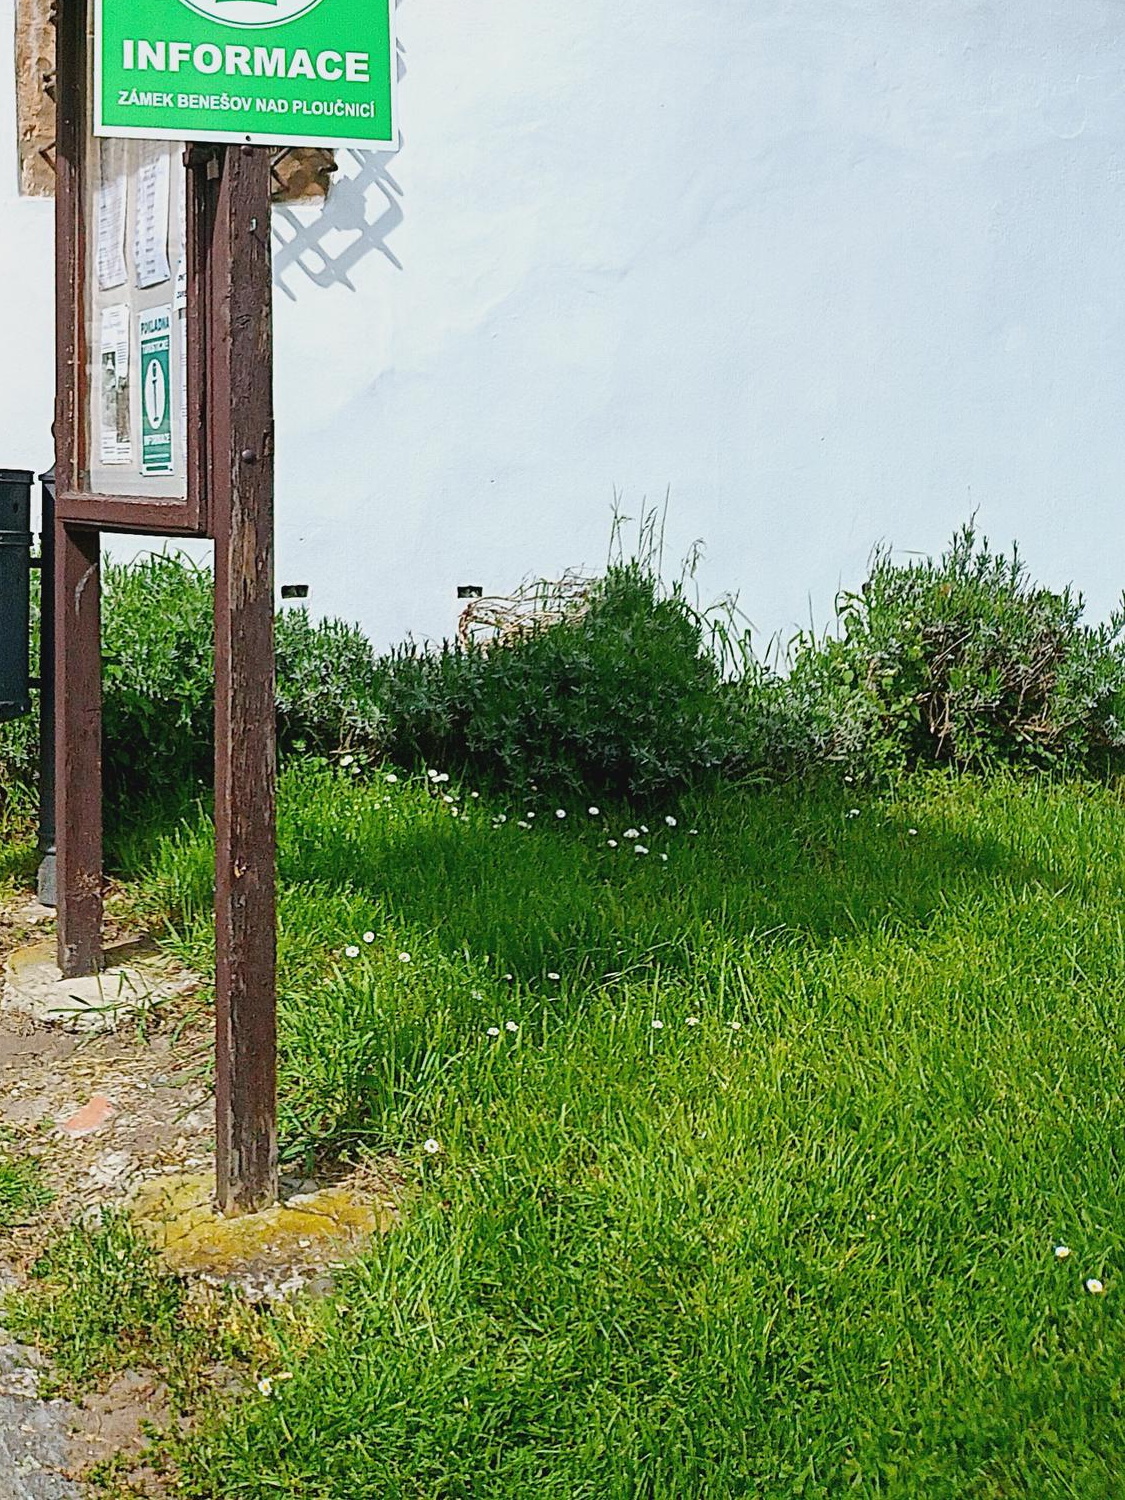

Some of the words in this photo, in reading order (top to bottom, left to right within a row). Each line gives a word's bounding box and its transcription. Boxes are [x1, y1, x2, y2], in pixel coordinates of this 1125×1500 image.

[123, 39, 370, 82] INFORMACE
[117, 88, 173, 108] ZÁMEK
[177, 92, 253, 112] BENEŠOV
[256, 99, 288, 114] NAD
[292, 98, 375, 118] PLOUČNICÍ
